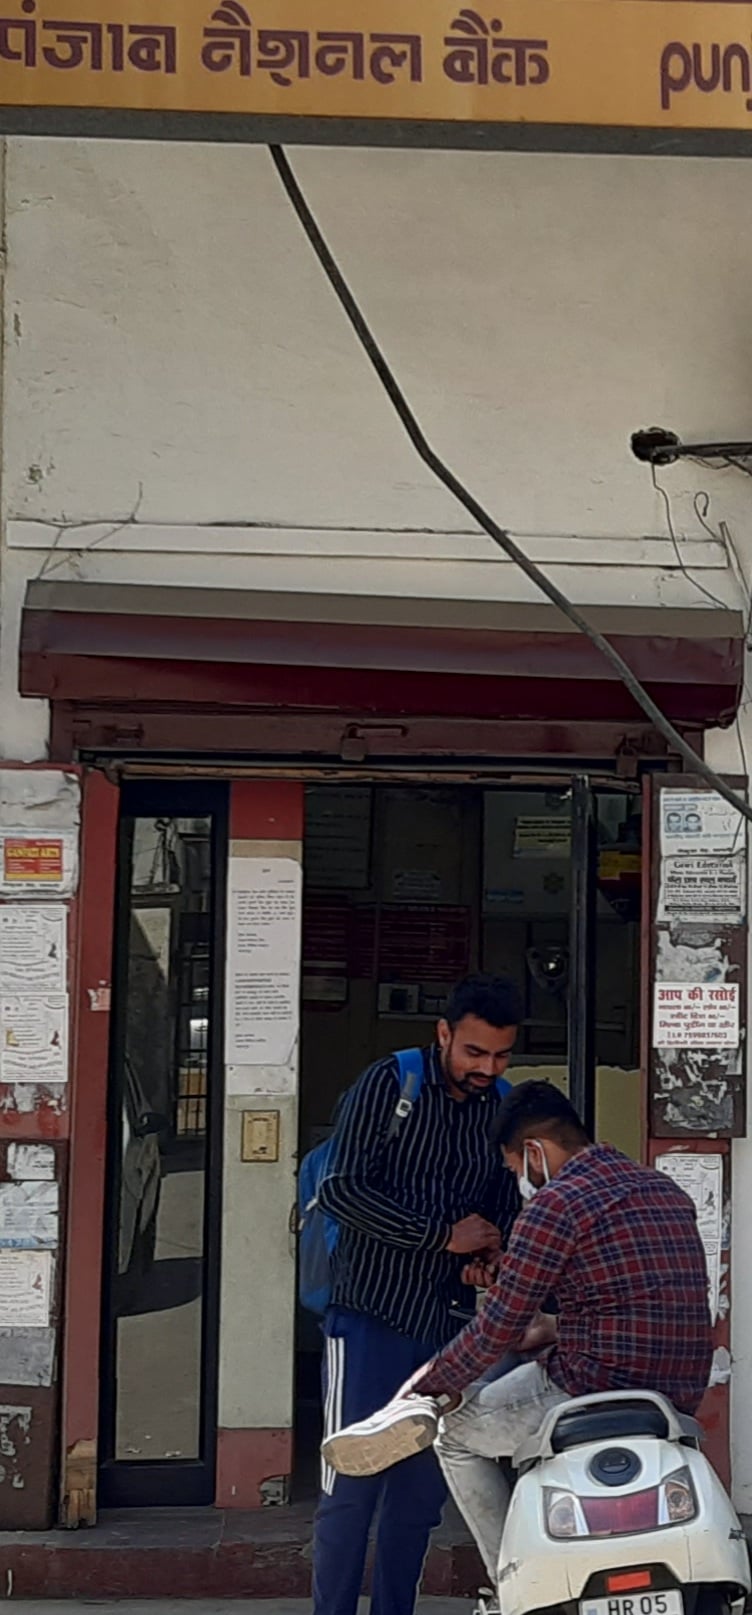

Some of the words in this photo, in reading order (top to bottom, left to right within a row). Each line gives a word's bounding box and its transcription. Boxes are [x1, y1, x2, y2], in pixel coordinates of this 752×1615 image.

[0, 0, 176, 73] पंजाब
[202, 0, 422, 86] नैशनल
[443, 9, 549, 86] बैंक
[660, 41, 752, 112] pun
[658, 989, 683, 1001] आप
[687, 986, 704, 1001] की
[707, 986, 737, 1002] रसोई
[608, 1599, 634, 1615] HR
[640, 1594, 667, 1615] 05
